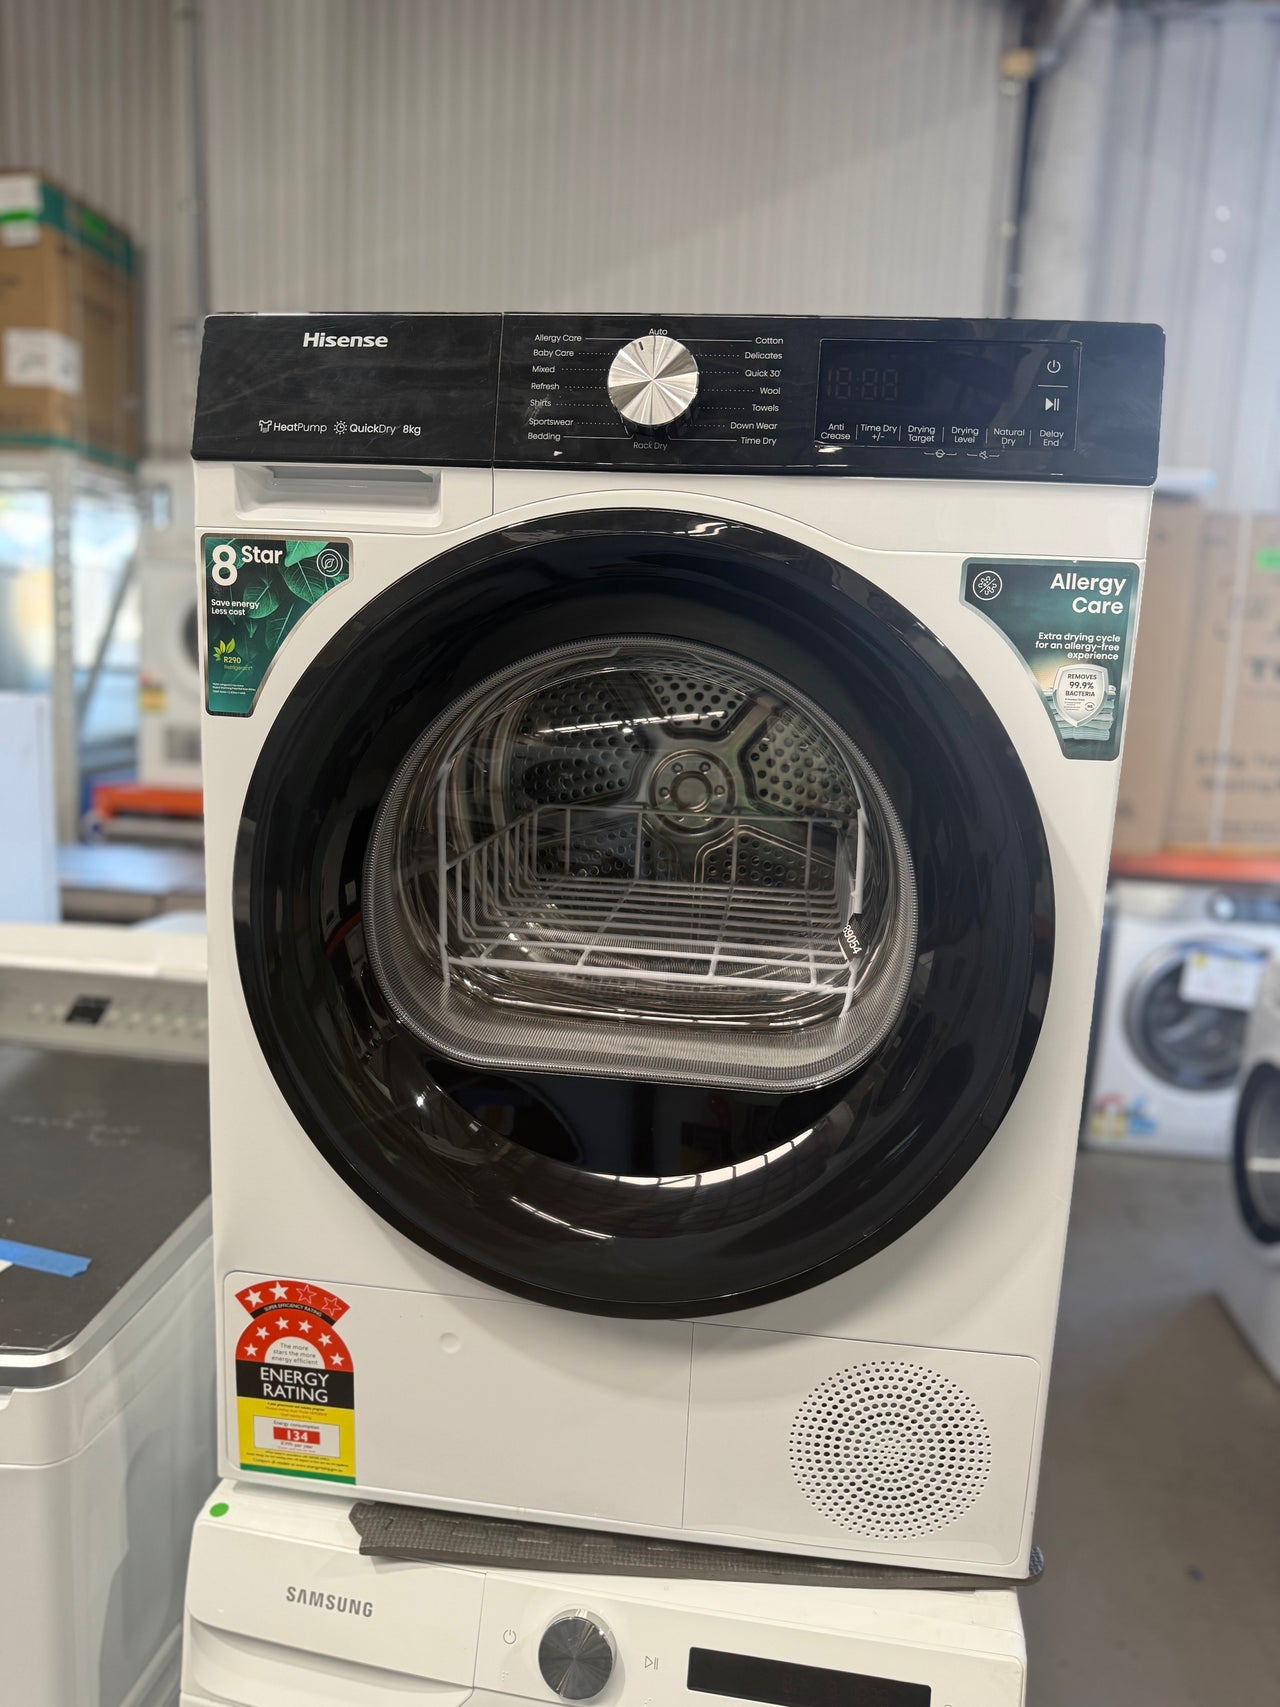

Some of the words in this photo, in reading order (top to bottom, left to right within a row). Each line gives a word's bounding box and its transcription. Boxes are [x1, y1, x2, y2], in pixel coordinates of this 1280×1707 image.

[649, 328, 668, 336] Auto
[303, 332, 389, 348] Hisense
[534, 334, 561, 343] Allergy
[562, 334, 582, 342] Care
[755, 337, 784, 345] Cotton
[533, 349, 554, 358] Baby
[554, 349, 574, 357] Care
[744, 351, 783, 360] Delicates
[532, 365, 555, 373] Mixed
[745, 369, 767, 378] Quick
[531, 382, 560, 390] Refresh
[759, 387, 781, 395] Wool
[530, 399, 551, 407] Shirts
[751, 404, 779, 412] Towels
[528, 418, 574, 427] Sportswear
[730, 422, 754, 430] Down
[755, 422, 778, 430] Wear
[828, 423, 844, 431] Anti
[273, 421, 327, 434] HeatPump
[349, 423, 397, 436] QuickDry
[402, 424, 421, 436] 8kg
[860, 424, 881, 432] Time
[882, 424, 897, 434] Dry
[908, 425, 936, 435] Drying
[951, 426, 979, 436] Drying
[528, 432, 561, 441] Bedding
[820, 432, 850, 440] Crease
[993, 428, 1025, 437] Natural
[1039, 430, 1064, 439] Delay
[740, 437, 760, 445] Time
[761, 437, 777, 446] Dry
[908, 434, 935, 443] Target
[954, 435, 976, 444] Level
[1001, 437, 1016, 446] Dry
[1043, 438, 1060, 447] End
[633, 441, 652, 449] Rack
[653, 442, 668, 451] Dry
[211, 544, 238, 586] 8
[241, 545, 283, 564] Star
[1050, 573, 1126, 596] Allergy
[211, 599, 230, 607] Save
[231, 600, 260, 610] energy
[1072, 597, 1124, 615] Care
[1038, 632, 1062, 641] Extra
[1063, 632, 1094, 643] drying
[1095, 633, 1121, 643] cycle
[1035, 641, 1049, 649] for
[1064, 641, 1120, 652] allergy-free
[223, 656, 241, 664] R290
[1067, 651, 1119, 661] experience
[1069, 681, 1095, 689] 99.9%
[842, 924, 863, 955] 89054
[292, 1357, 319, 1365] efficient
[260, 1366, 330, 1388] ENERGY
[263, 1383, 328, 1403] RATING
[287, 1429, 309, 1442] 134
[286, 1586, 374, 1618] SAMSUNG
